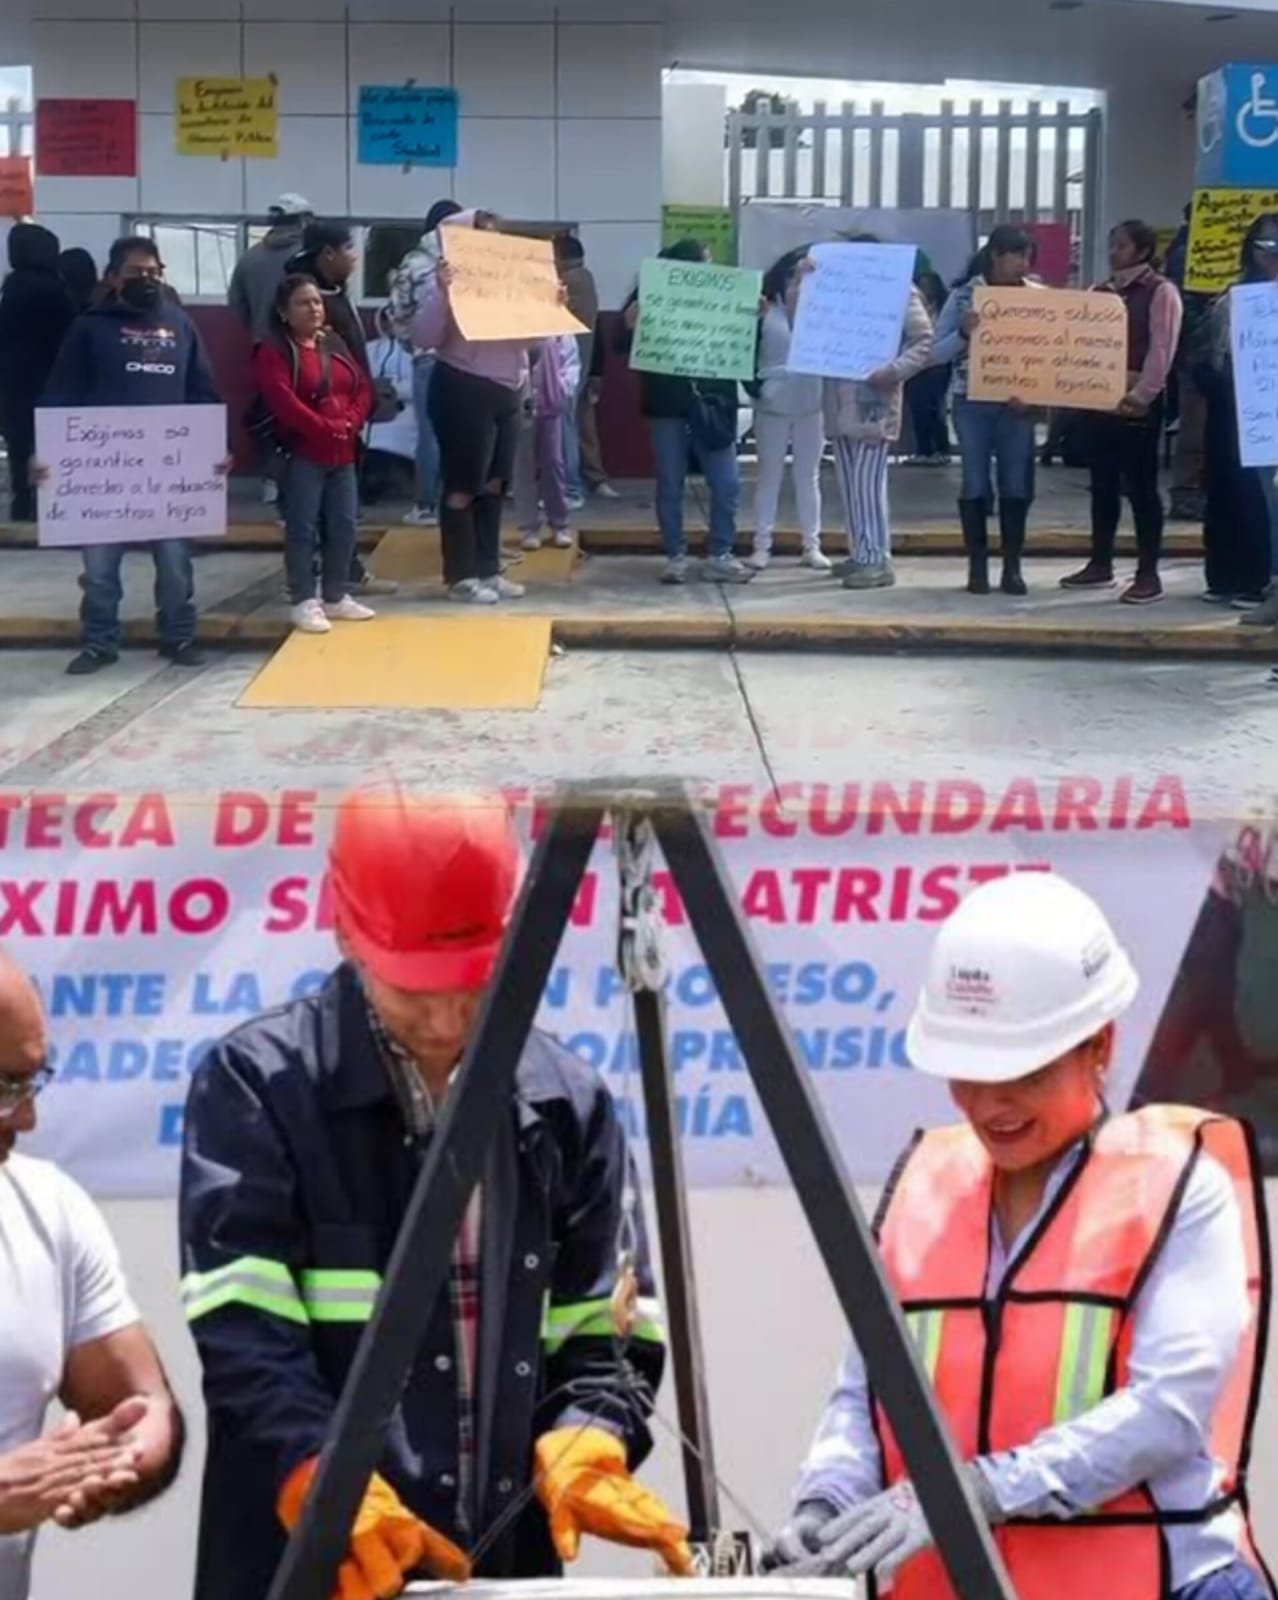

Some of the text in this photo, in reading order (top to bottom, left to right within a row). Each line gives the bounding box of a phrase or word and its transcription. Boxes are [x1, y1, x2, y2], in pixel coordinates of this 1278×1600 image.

[59, 448, 181, 476] garantice el
[46, 502, 67, 521] de
[214, 790, 318, 847] DE
[0, 878, 230, 937] XIMO
[190, 972, 262, 1015] LA
